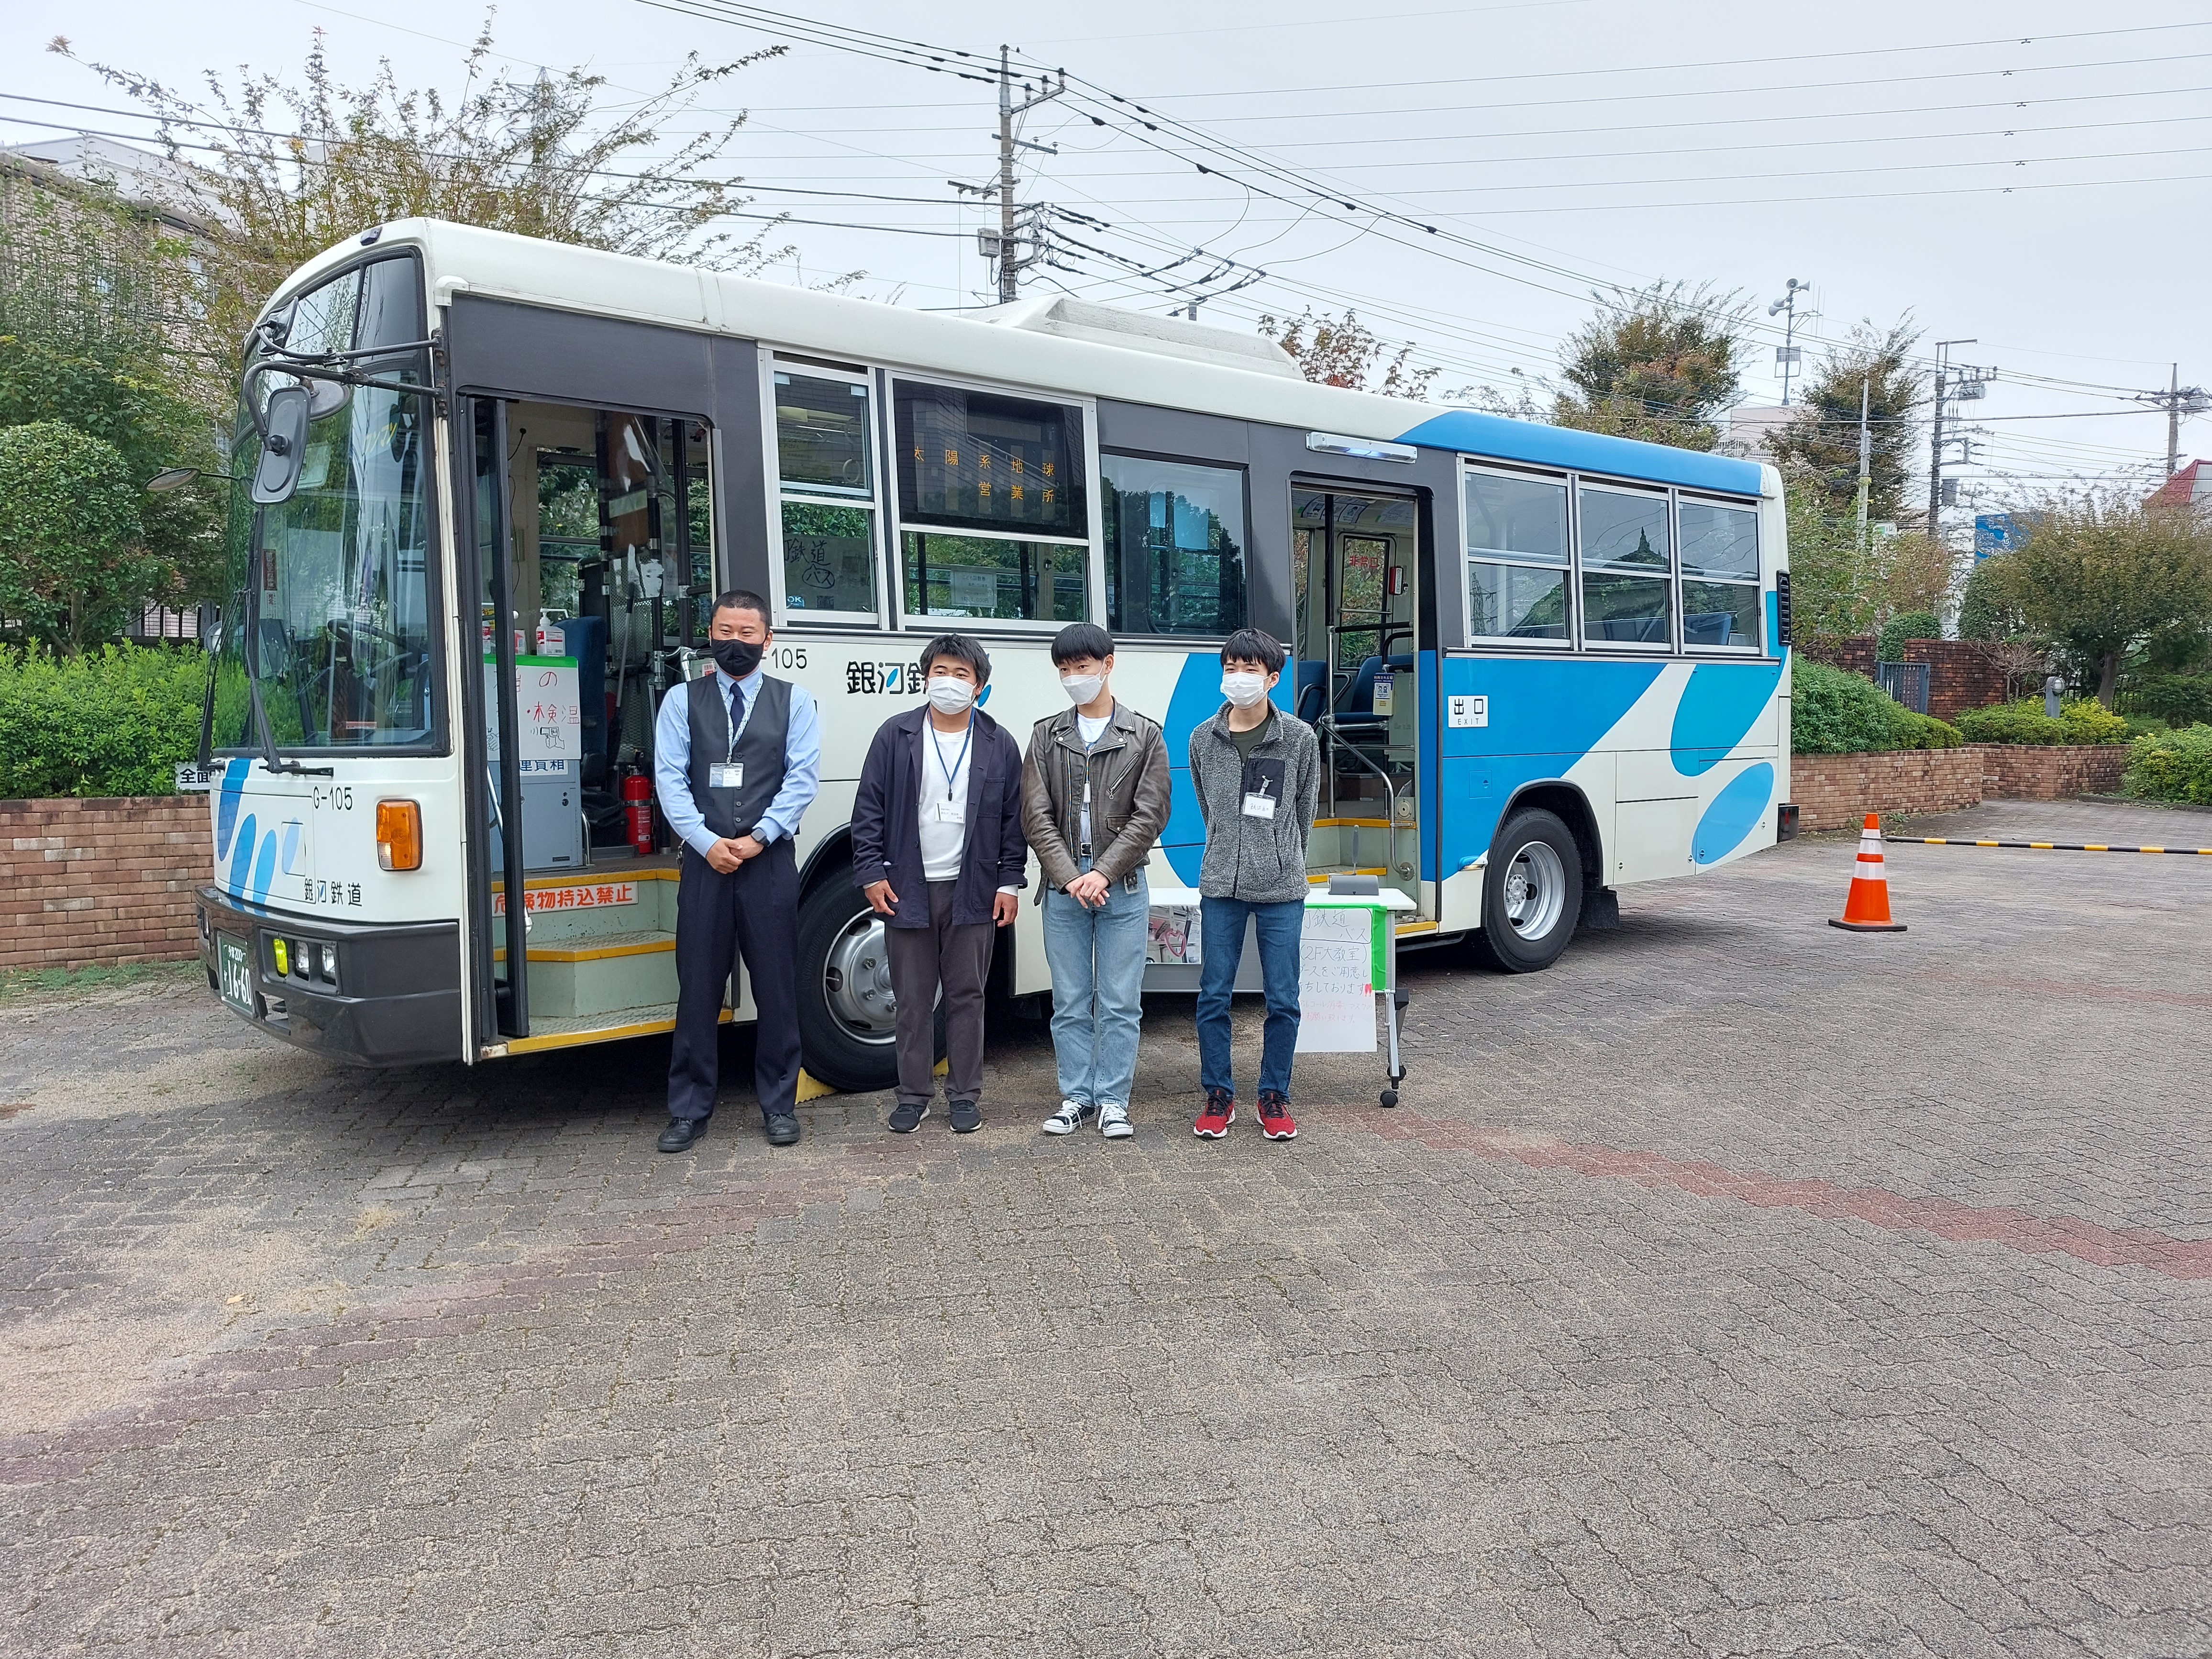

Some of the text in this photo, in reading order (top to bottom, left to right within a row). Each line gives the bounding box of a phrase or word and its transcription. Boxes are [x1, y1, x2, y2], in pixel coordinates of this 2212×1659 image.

[914, 446, 1055, 477] 太陽系地球
[979, 481, 1054, 503] 営業所
[1349, 555, 1378, 568] 非常口
[807, 571, 834, 586] バス
[1454, 698, 1483, 715] 出口
[313, 786, 353, 810] G-105
[304, 878, 362, 907] 銀河鉄道
[1339, 928, 1369, 942] バス
